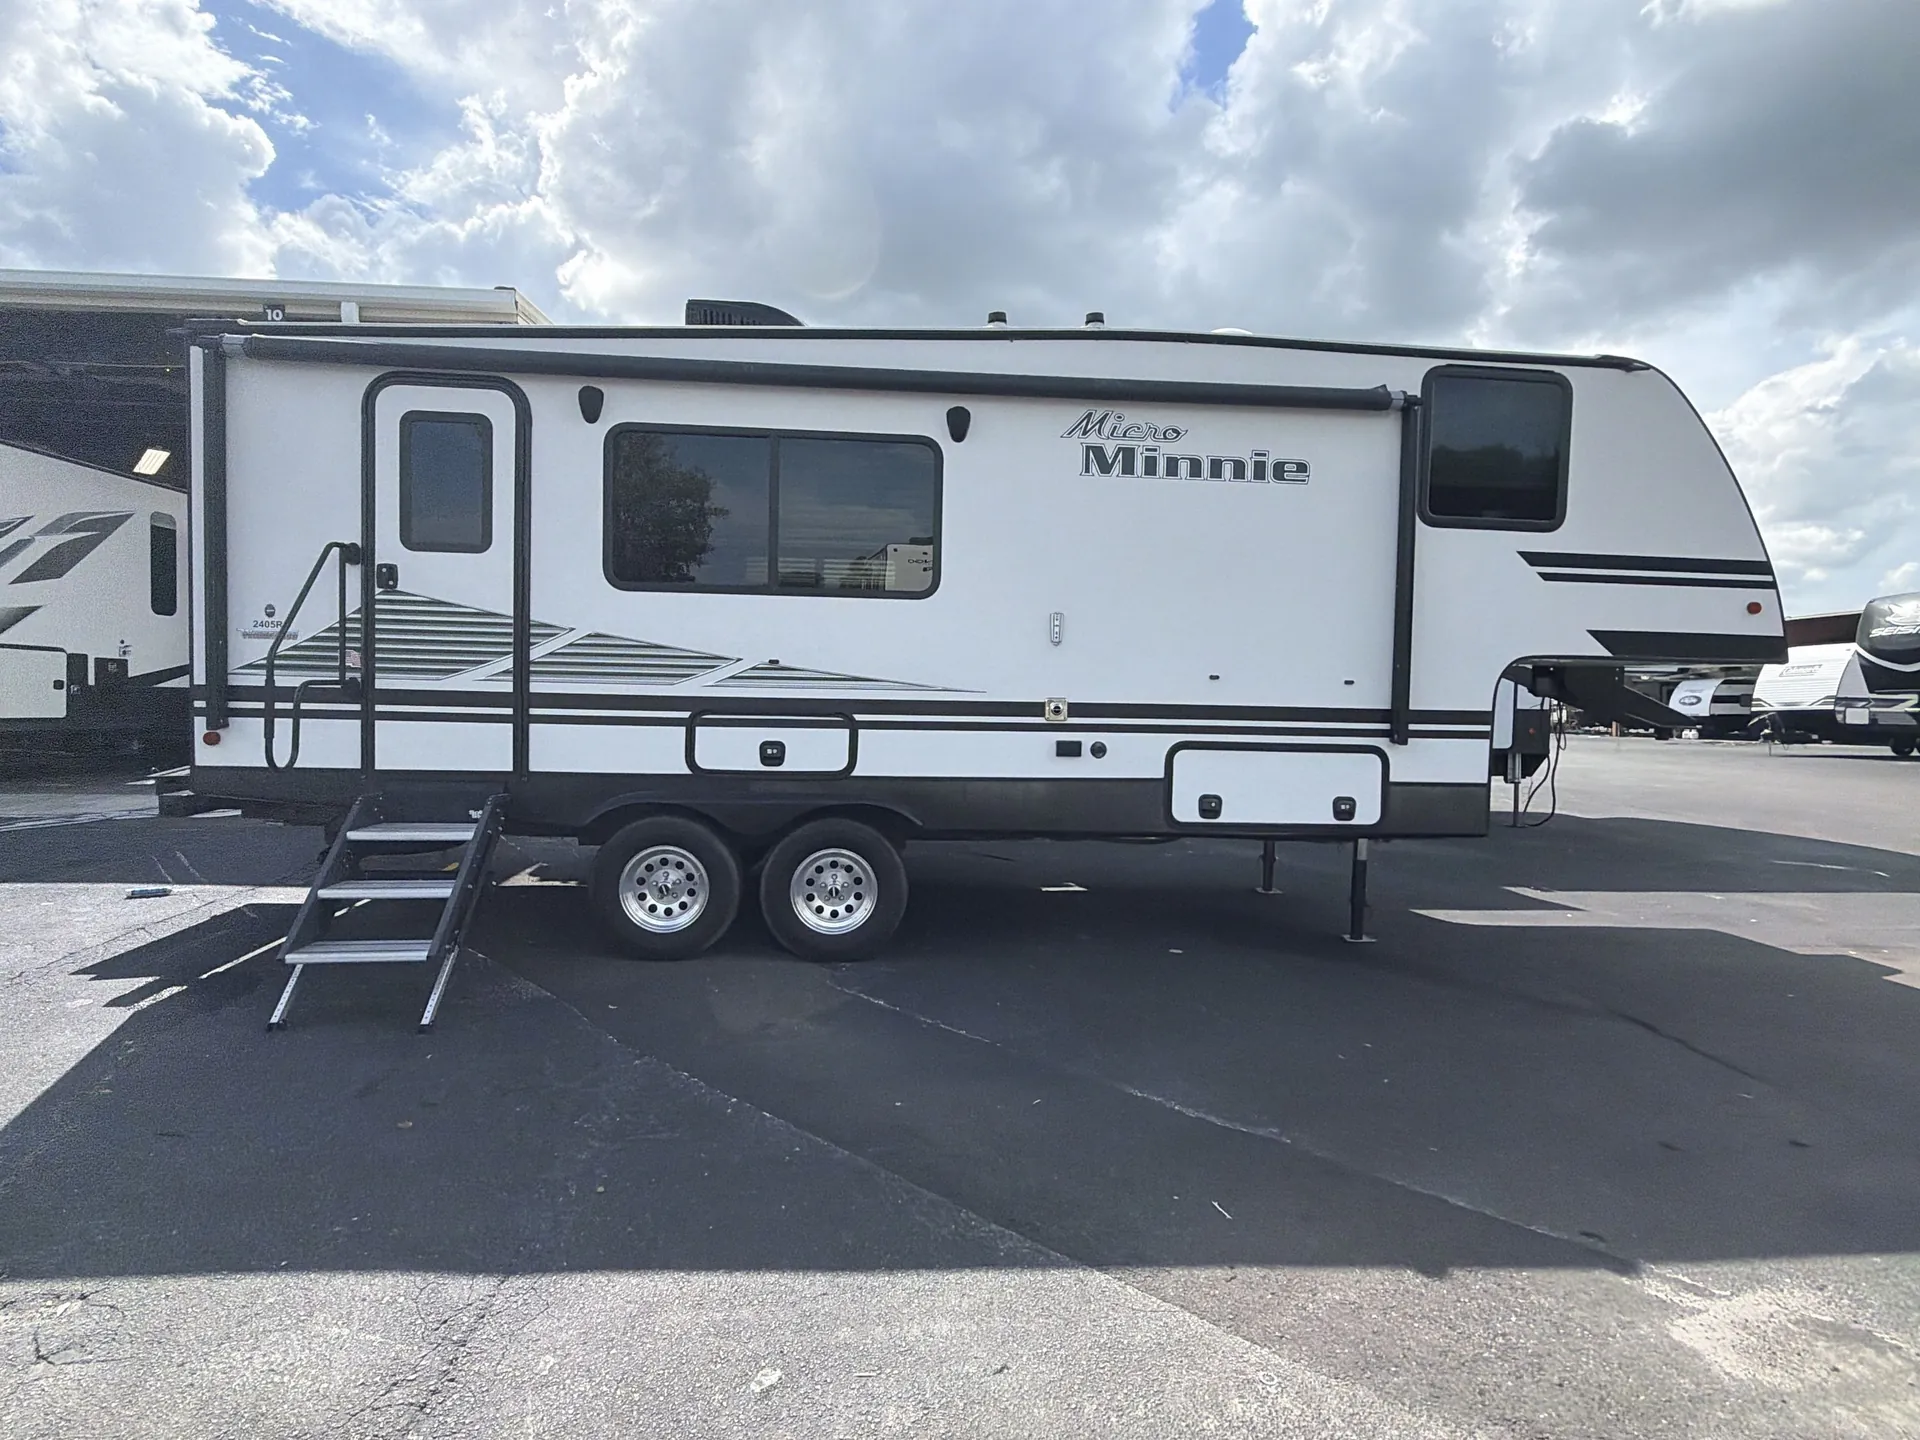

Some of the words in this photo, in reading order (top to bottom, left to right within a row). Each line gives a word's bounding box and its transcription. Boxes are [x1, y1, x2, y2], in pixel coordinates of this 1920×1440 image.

[265, 309, 284, 321] 10
[1060, 409, 1188, 442] Micro
[1079, 442, 1311, 485] Minnie
